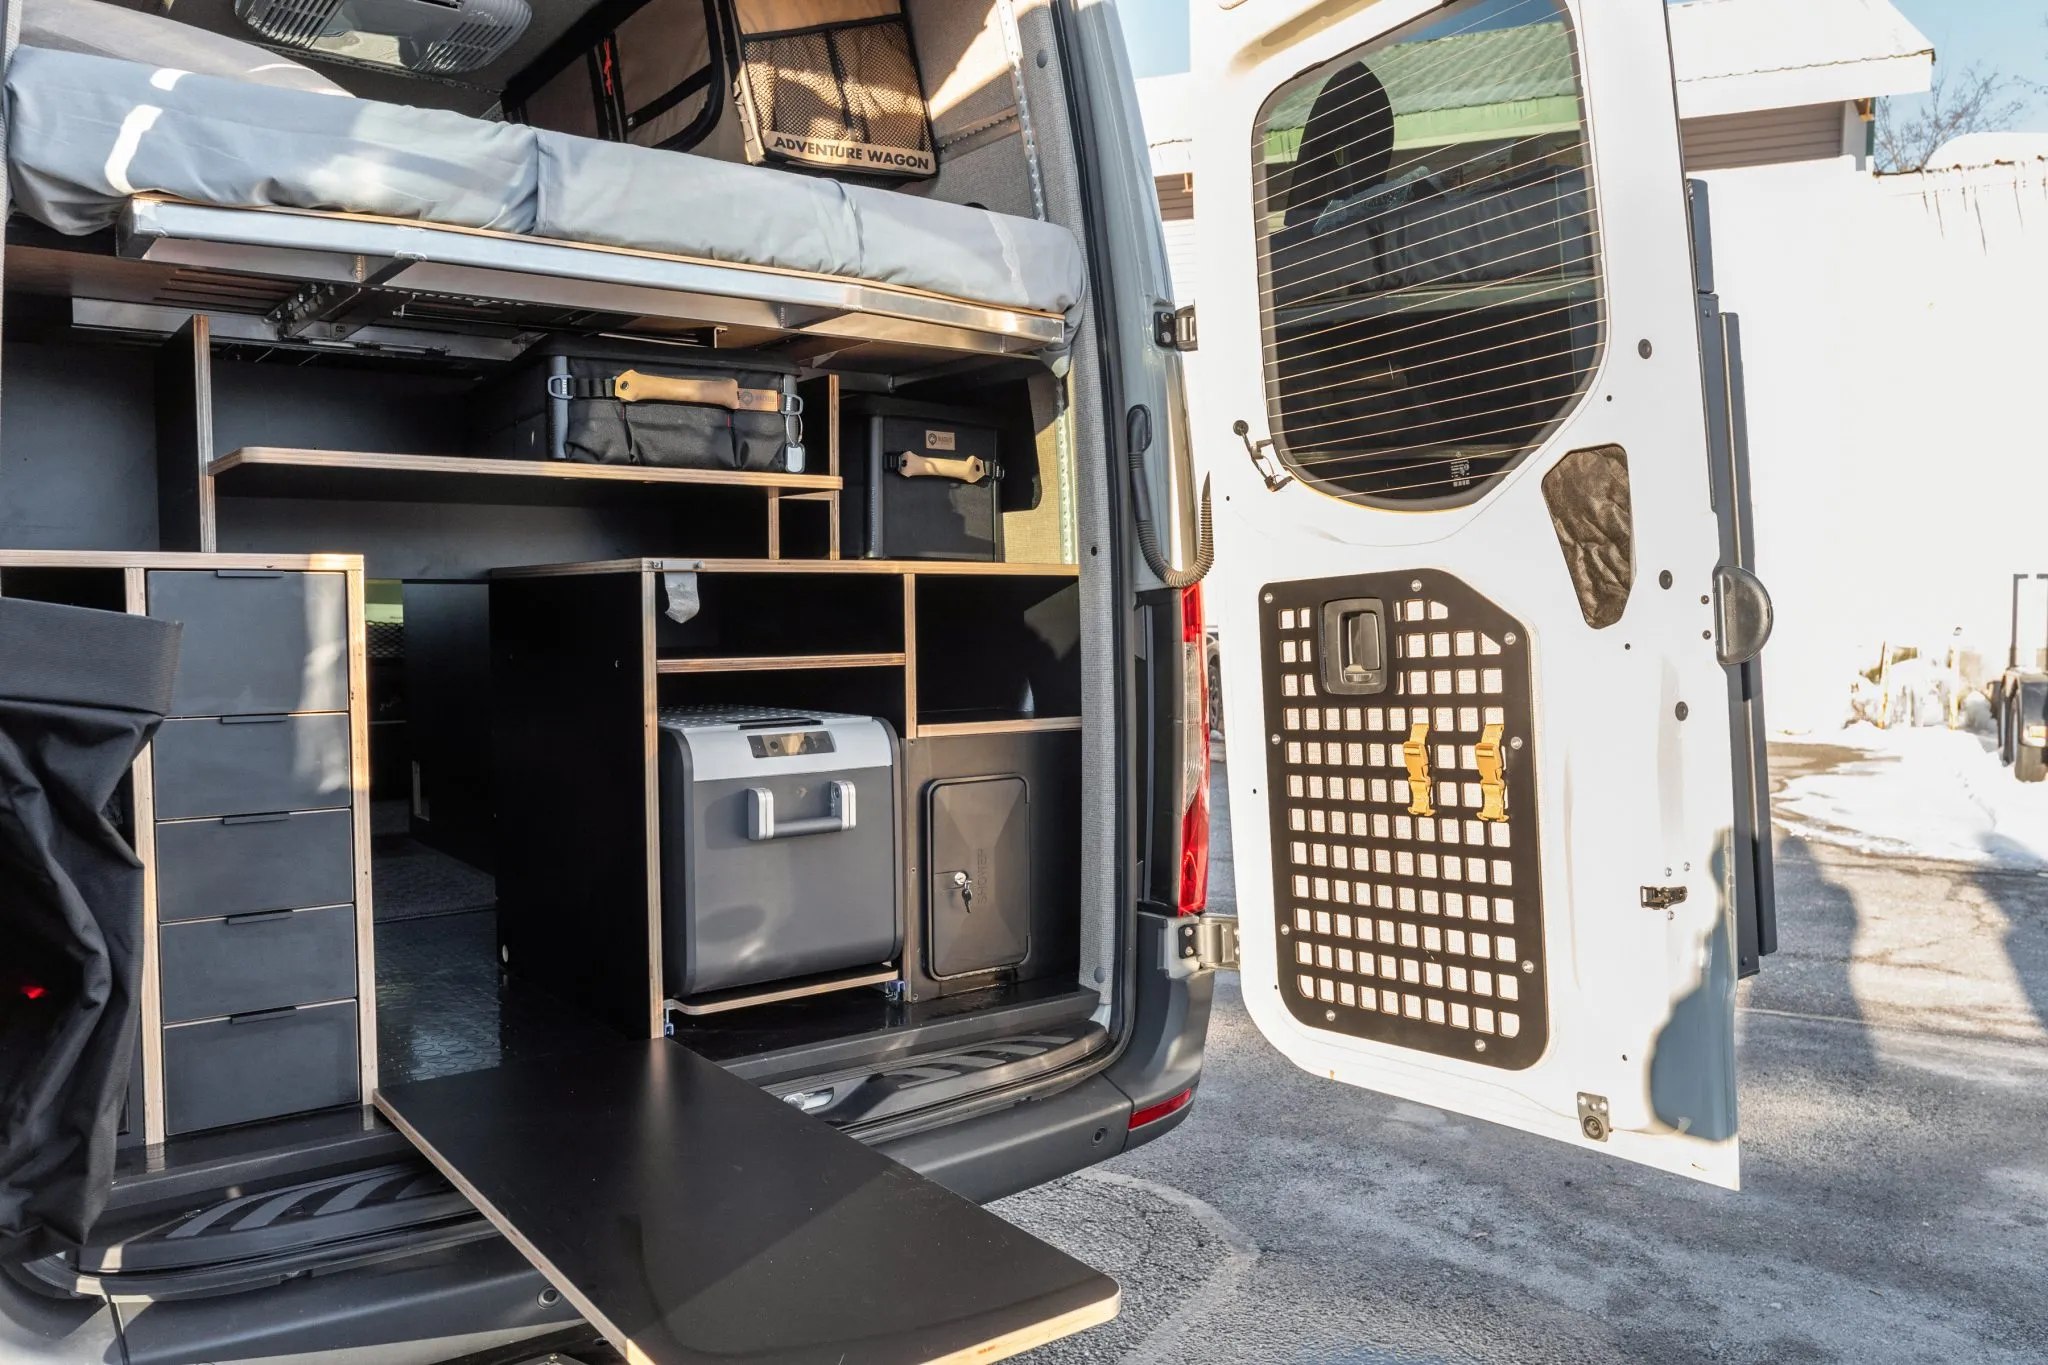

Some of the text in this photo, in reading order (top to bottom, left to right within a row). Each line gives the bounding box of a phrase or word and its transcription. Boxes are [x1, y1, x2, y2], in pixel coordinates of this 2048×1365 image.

[774, 136, 929, 170] ADVENTURE WAGON
[977, 848, 987, 904] SHOWER
